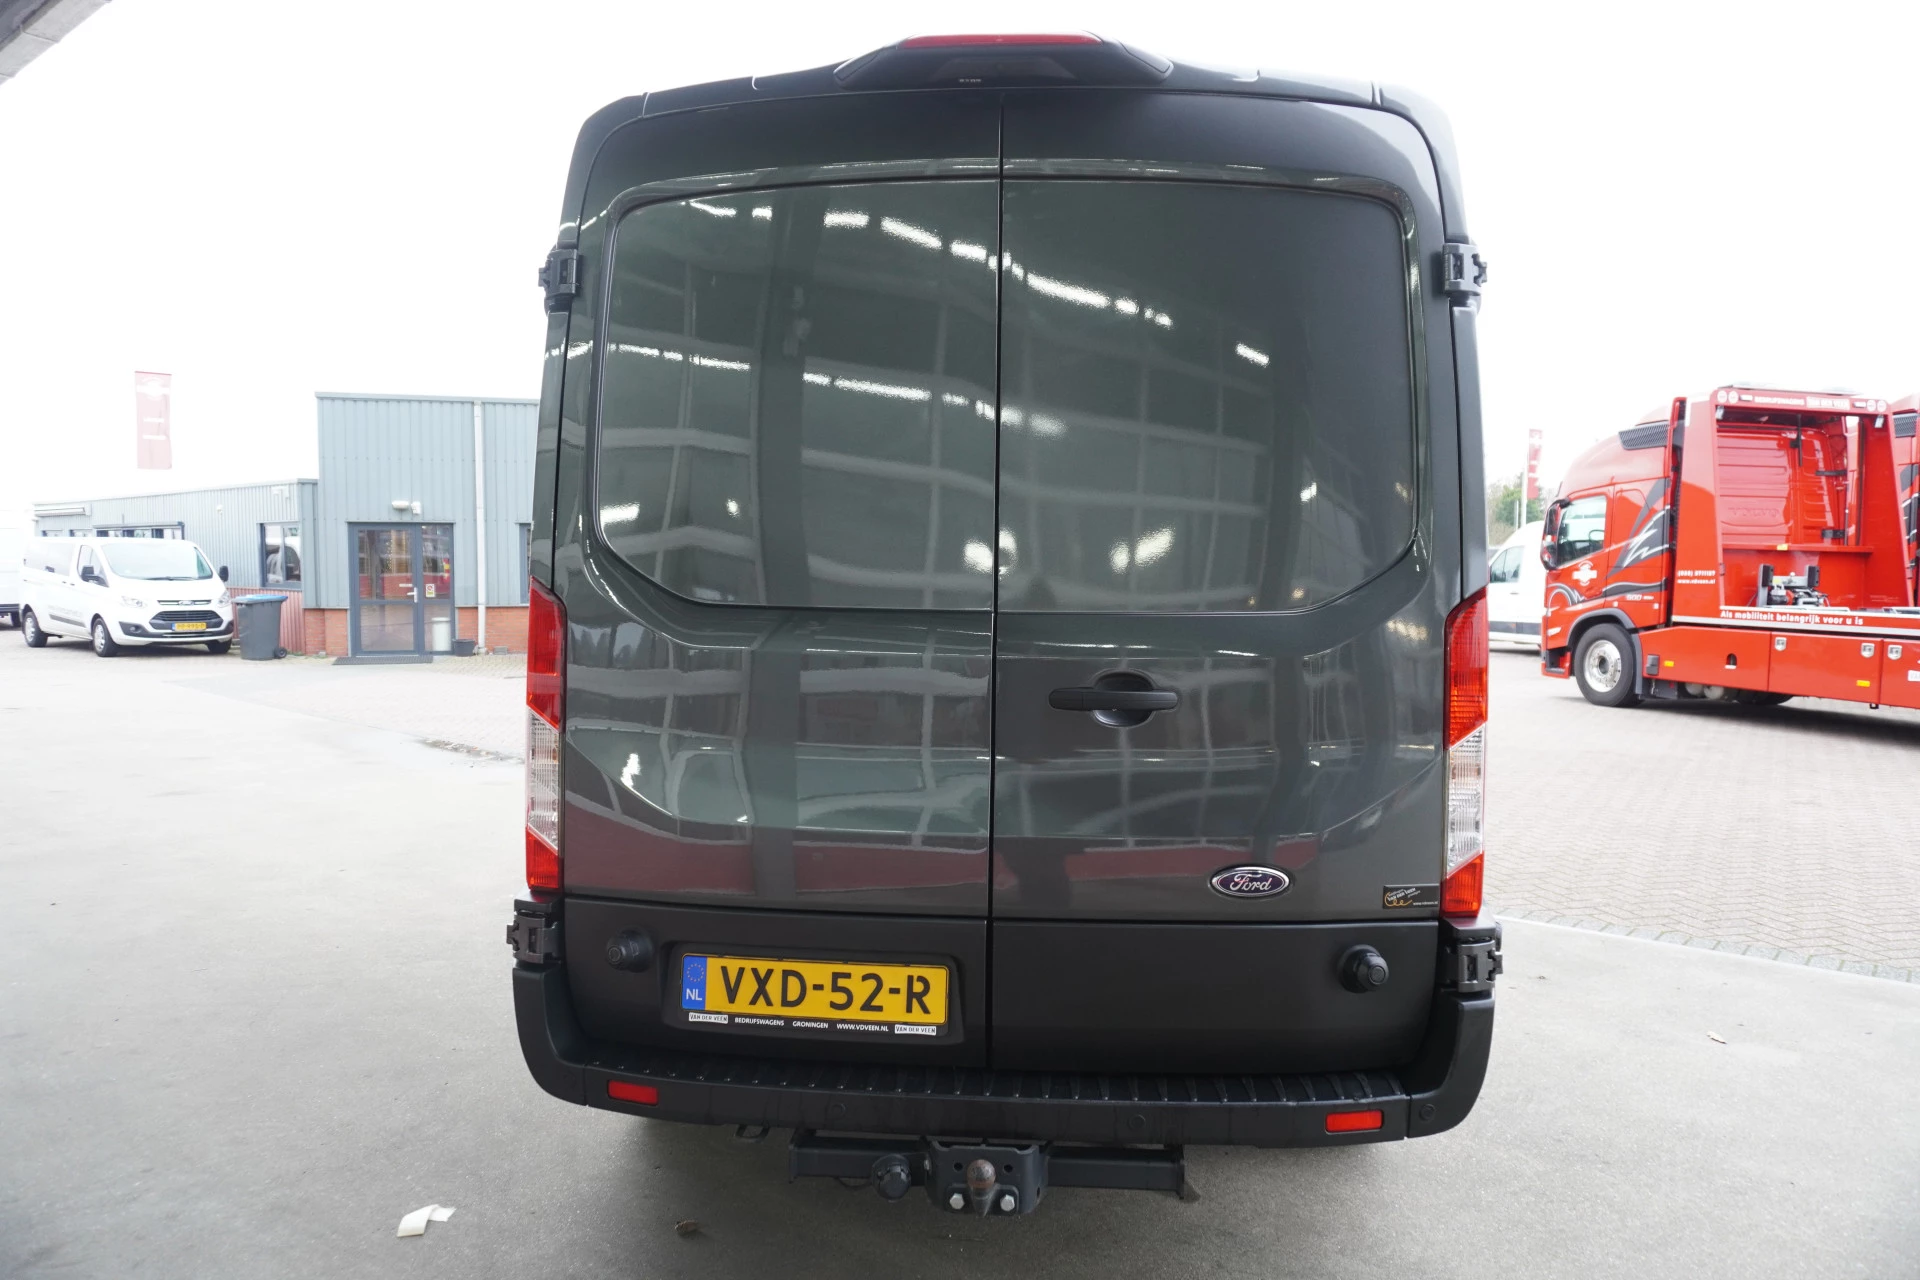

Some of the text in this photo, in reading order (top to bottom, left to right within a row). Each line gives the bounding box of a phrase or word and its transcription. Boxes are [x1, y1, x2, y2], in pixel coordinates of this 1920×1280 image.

[1720, 610, 1732, 619] Als
[1735, 611, 1774, 621] mobiliteit
[1776, 613, 1820, 625] belangrijk
[1823, 616, 1843, 625] voor
[1855, 616, 1864, 626] is
[1230, 874, 1272, 891] Ford
[686, 965, 932, 1015] NL VXD-52-R
[792, 1020, 829, 1029] GRONINGEN
[836, 1023, 889, 1032] WWW.VDVEEN.NL
[921, 1026, 936, 1034] VEEN
